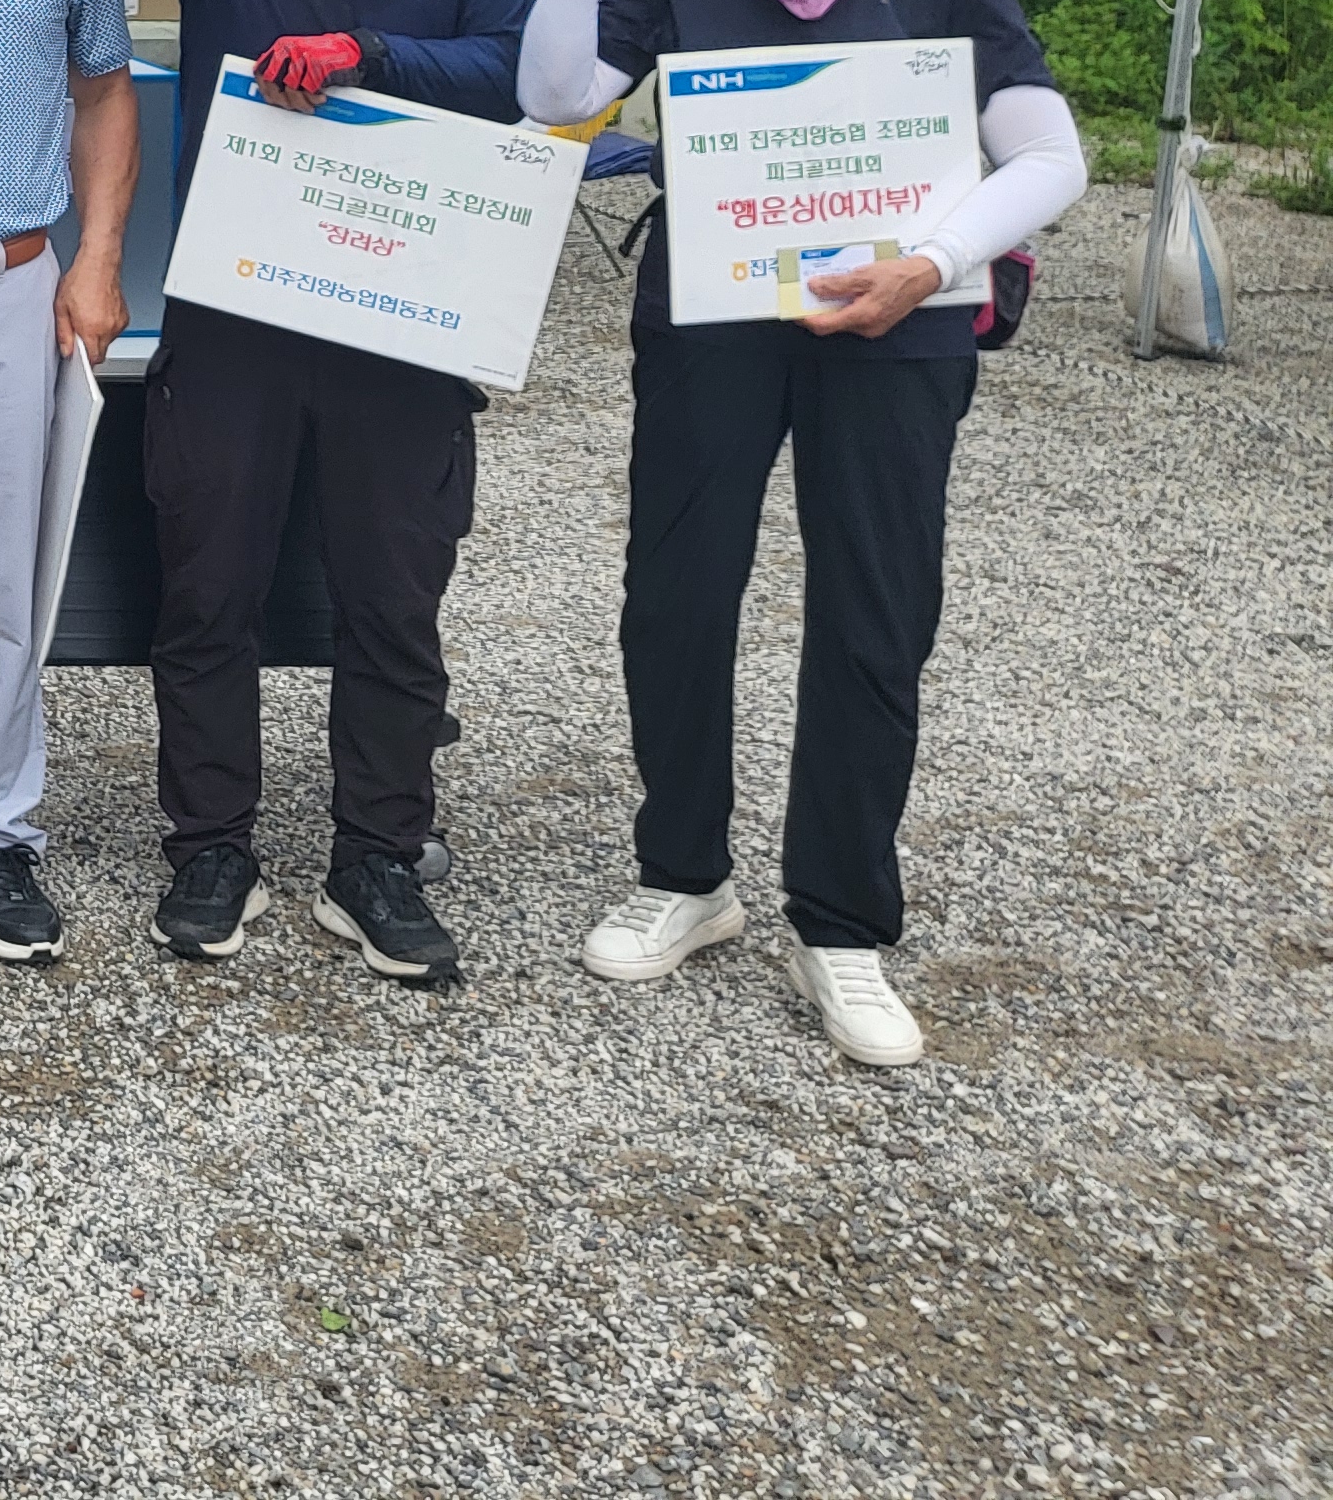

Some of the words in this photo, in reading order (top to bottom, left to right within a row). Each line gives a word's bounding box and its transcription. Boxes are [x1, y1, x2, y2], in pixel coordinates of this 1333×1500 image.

[690, 70, 745, 91] NH
[686, 131, 739, 156] 제1회
[748, 121, 867, 151] 진주진양농협
[877, 115, 951, 139] 조합장배
[222, 133, 282, 166] 제1회
[292, 150, 429, 201] 진주진양농협
[438, 187, 533, 228] 조합장배
[765, 153, 883, 183] 파크골프대회
[298, 185, 439, 237] 파크골프대회
[255, 261, 464, 331] 진주진양농업협동조합
